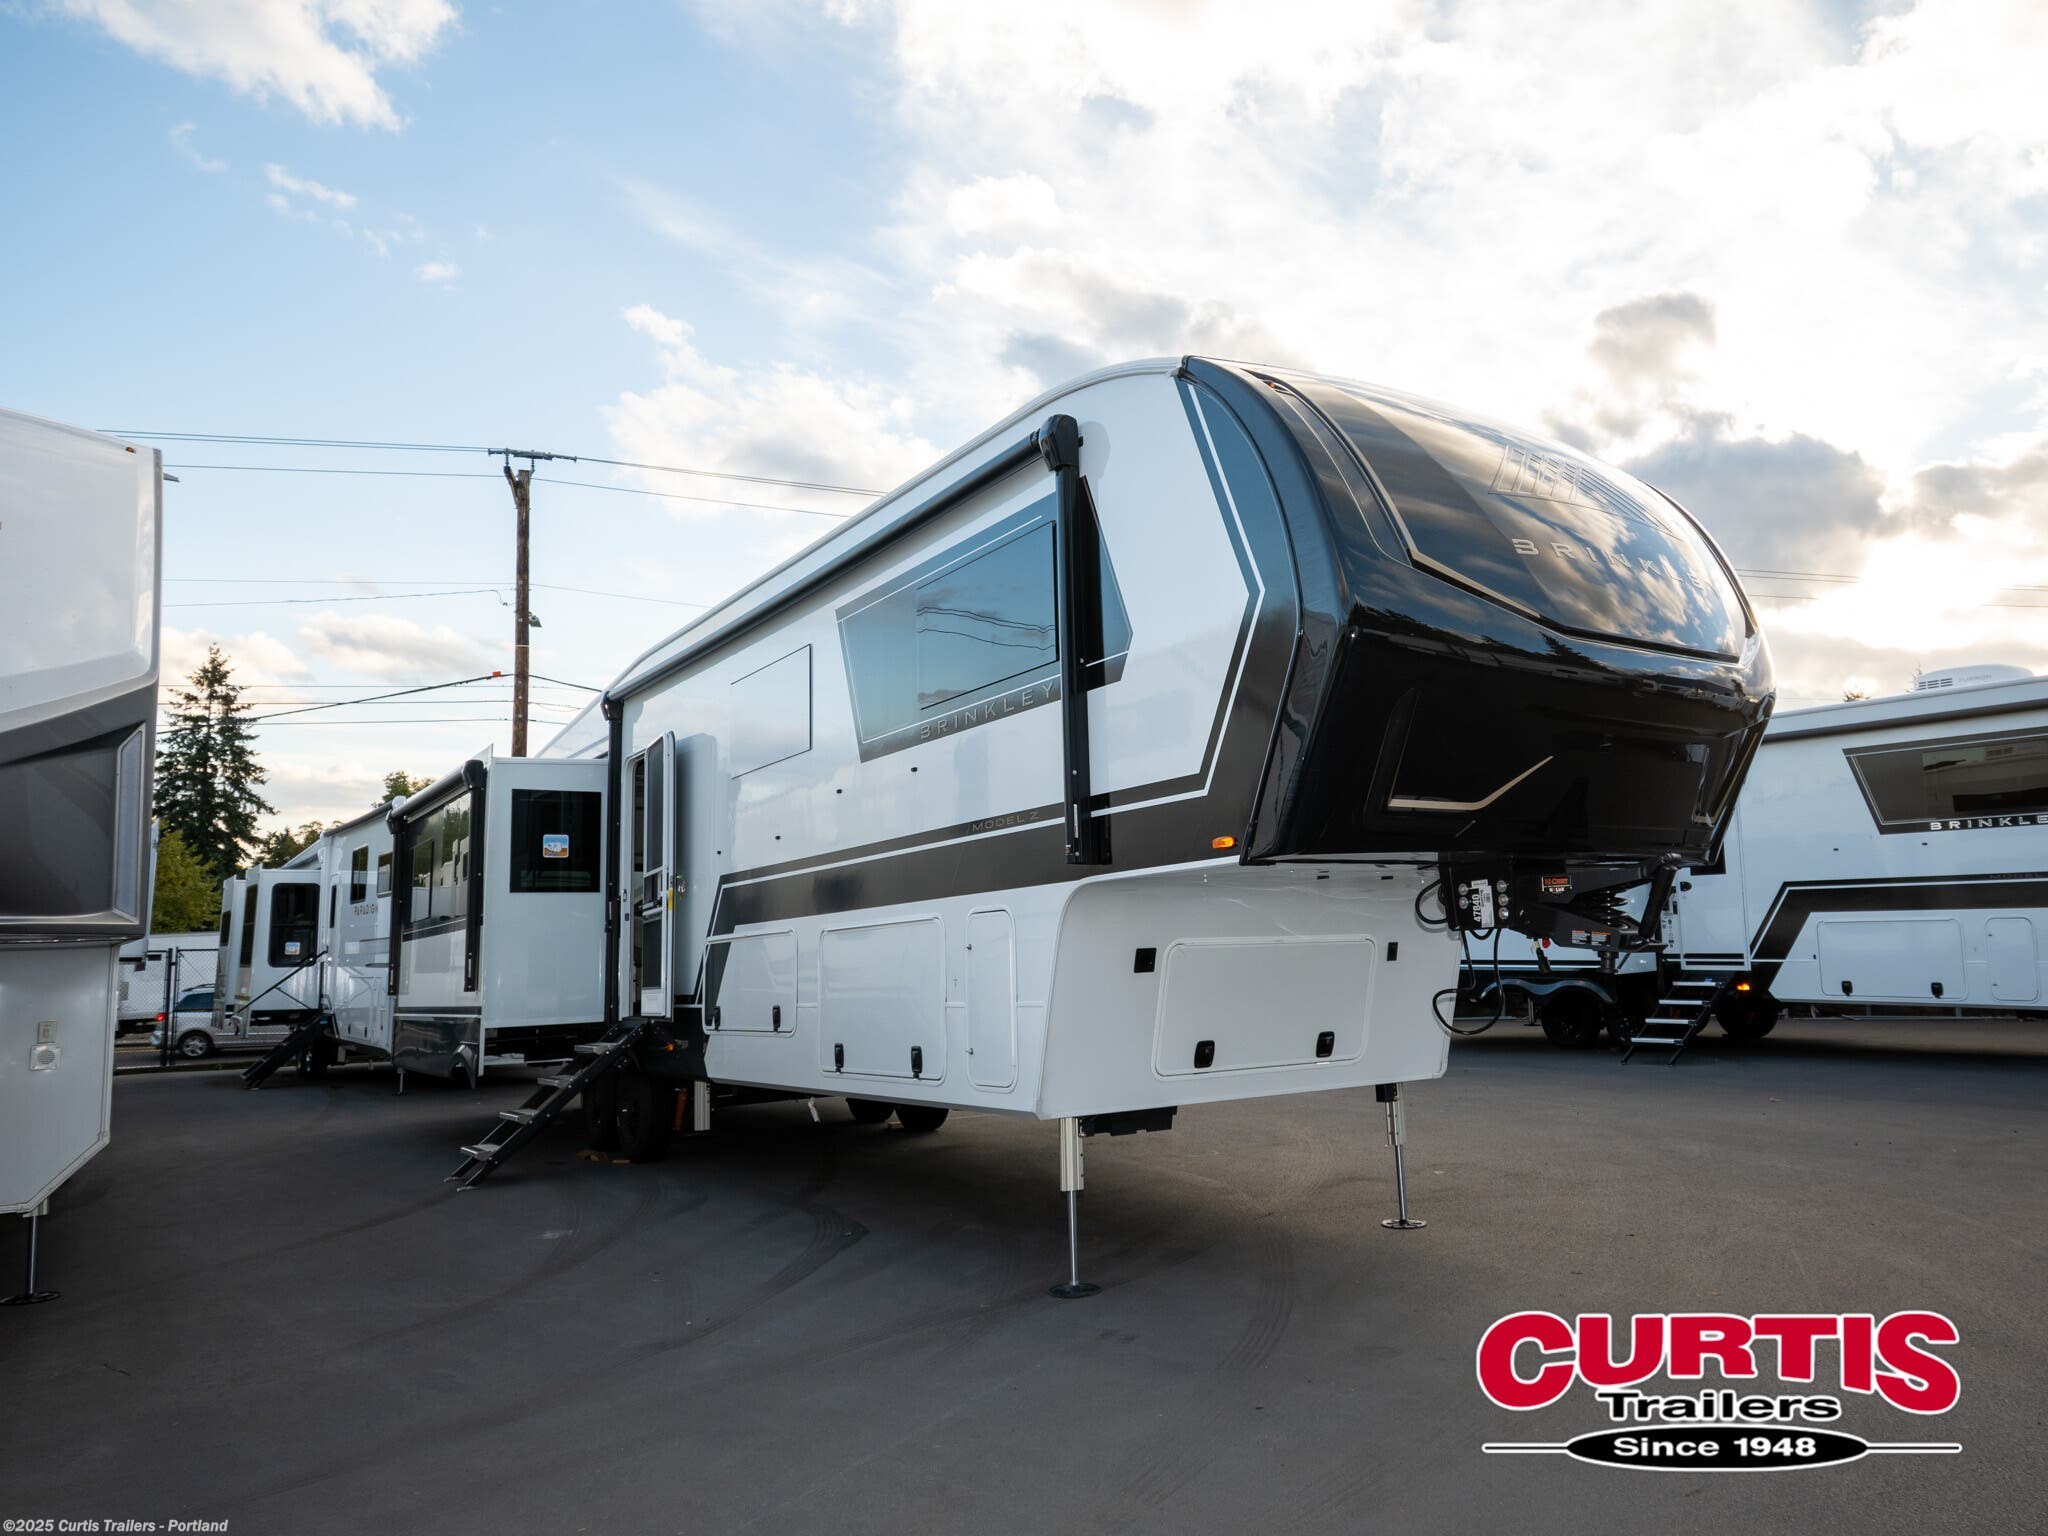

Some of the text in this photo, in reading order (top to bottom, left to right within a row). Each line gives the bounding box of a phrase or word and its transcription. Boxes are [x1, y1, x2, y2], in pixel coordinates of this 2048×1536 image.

[1511, 538, 1716, 596] BRINKLE
[920, 680, 1056, 739] BRINKLEY
[972, 810, 1041, 833] MODEL Z
[1471, 894, 1481, 922] 47840
